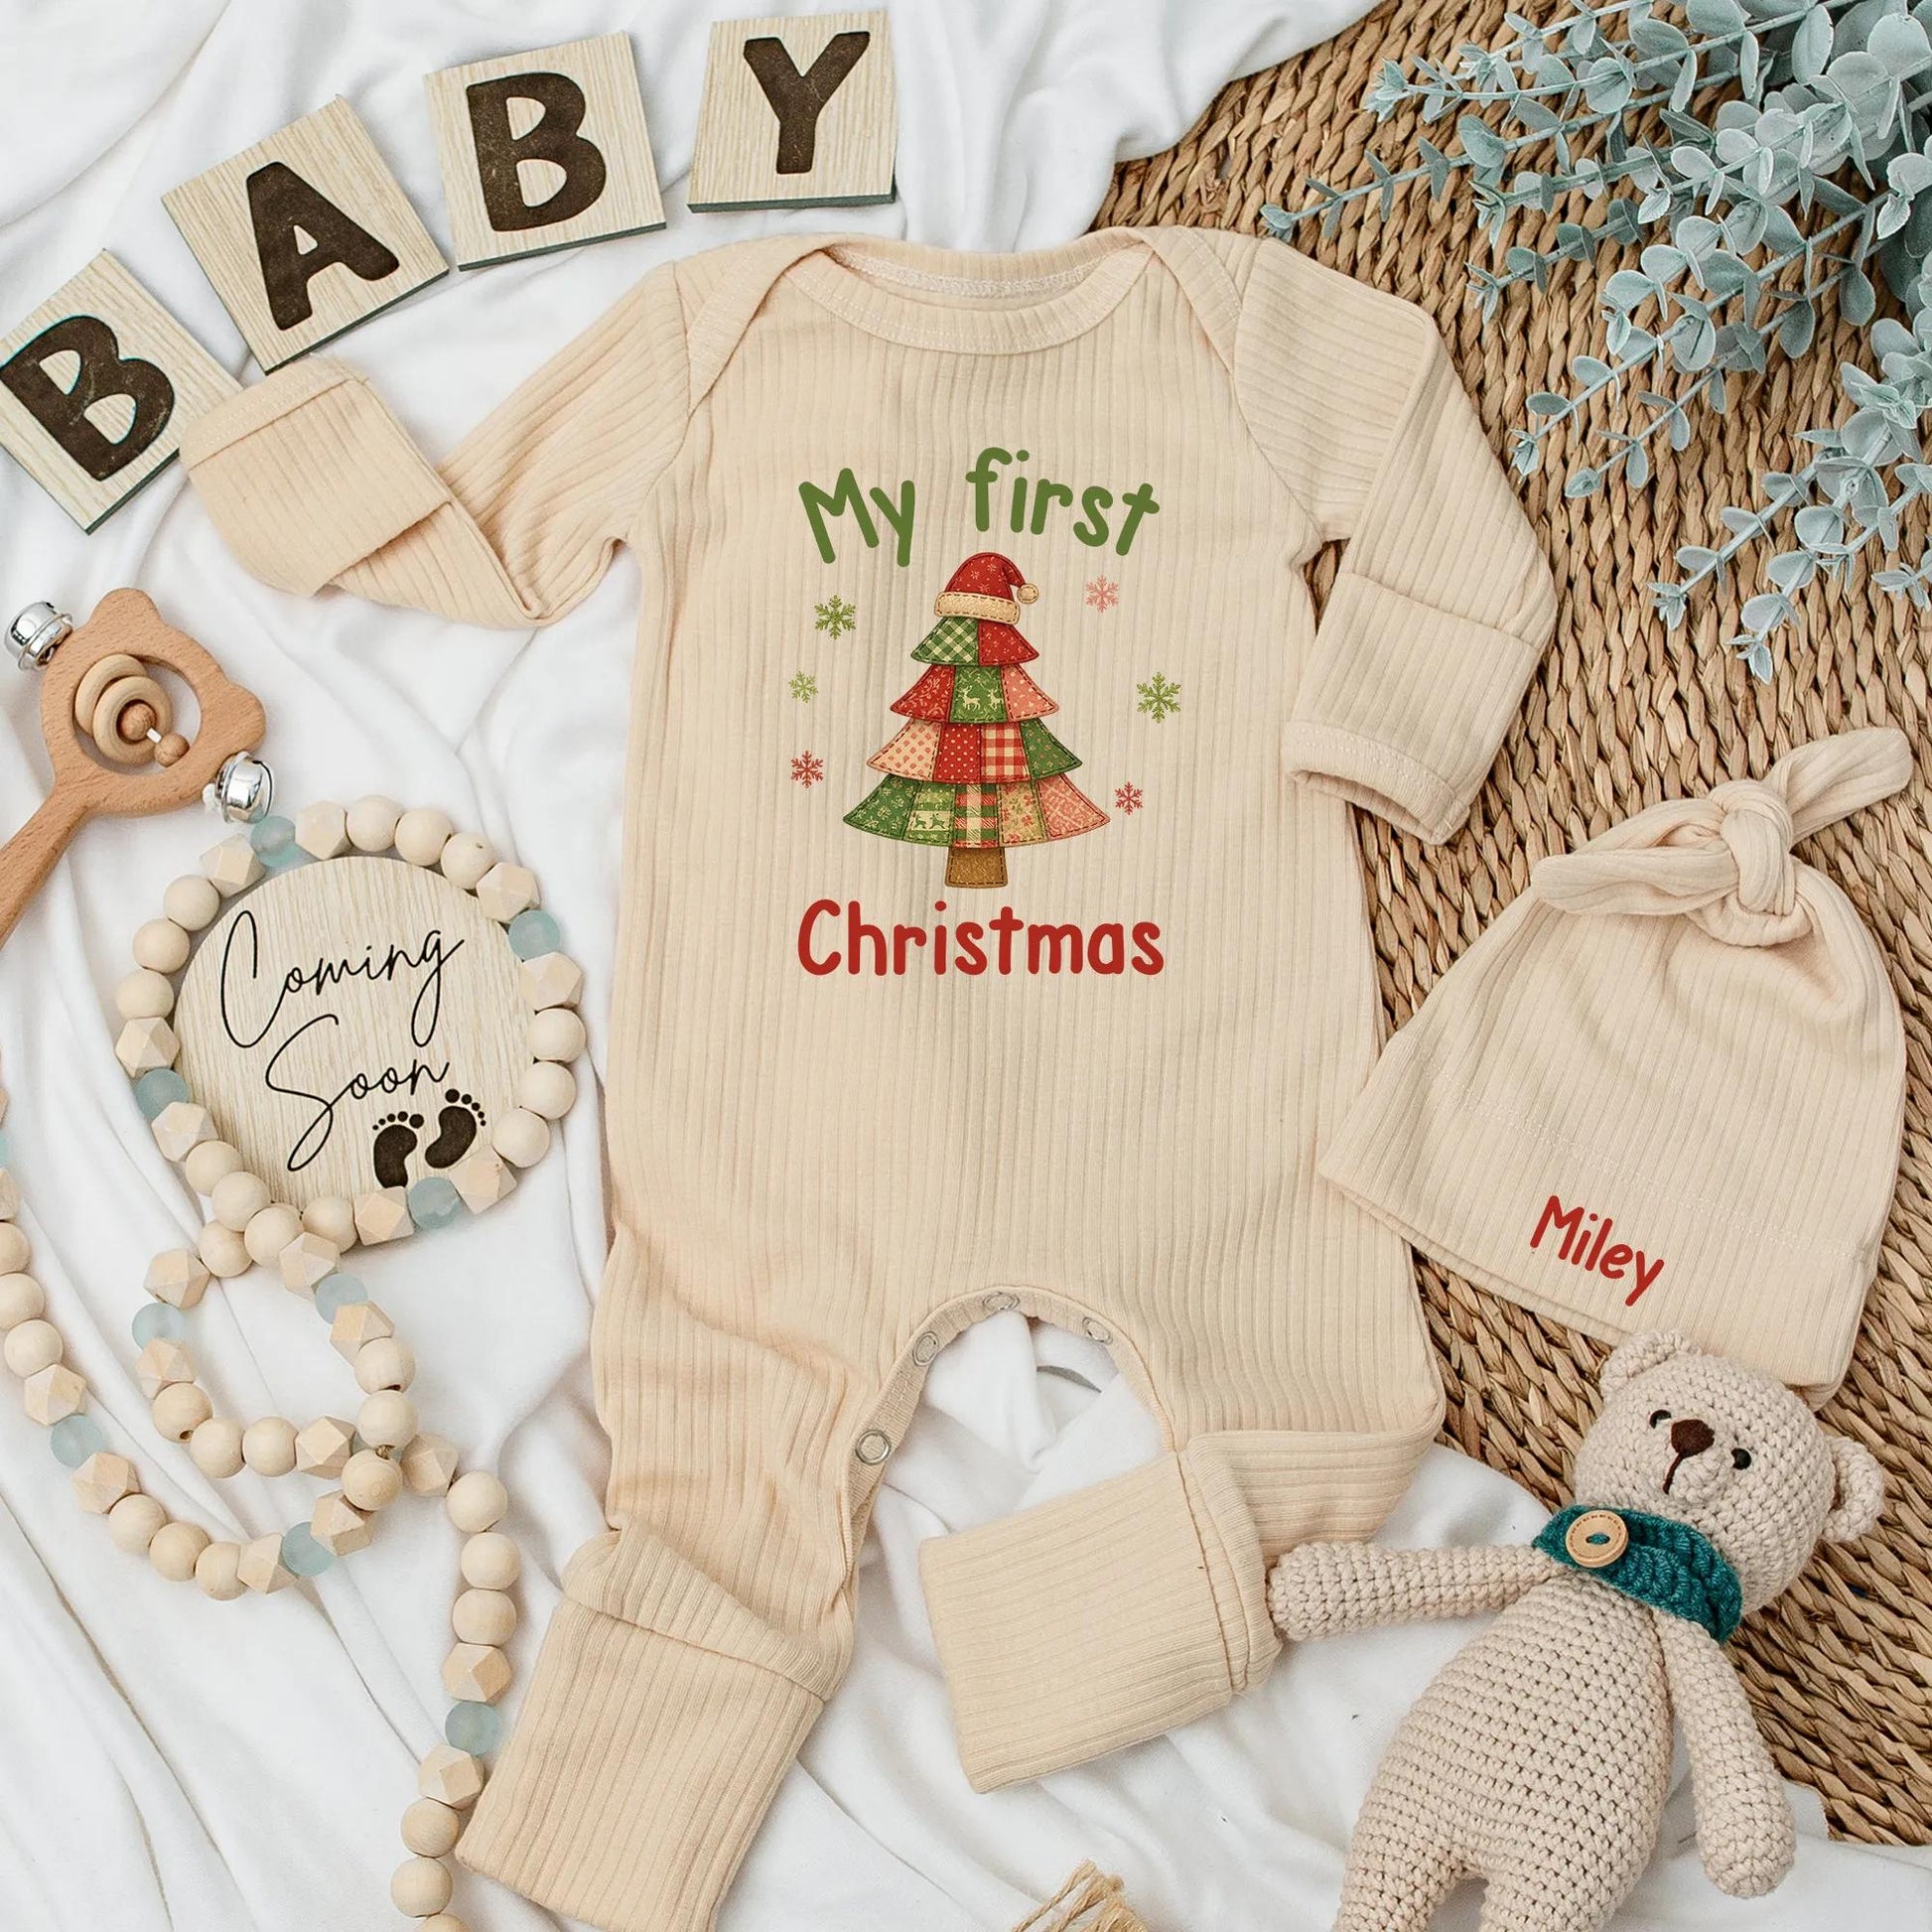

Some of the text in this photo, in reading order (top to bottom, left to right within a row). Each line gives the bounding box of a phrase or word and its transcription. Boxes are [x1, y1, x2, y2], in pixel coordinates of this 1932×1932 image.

[798, 447, 1161, 567] My first
[220, 909, 466, 1048] Coming
[797, 898, 1165, 976] Christmas
[264, 1013, 451, 1173] Soon
[1529, 1194, 1665, 1307] Miley
